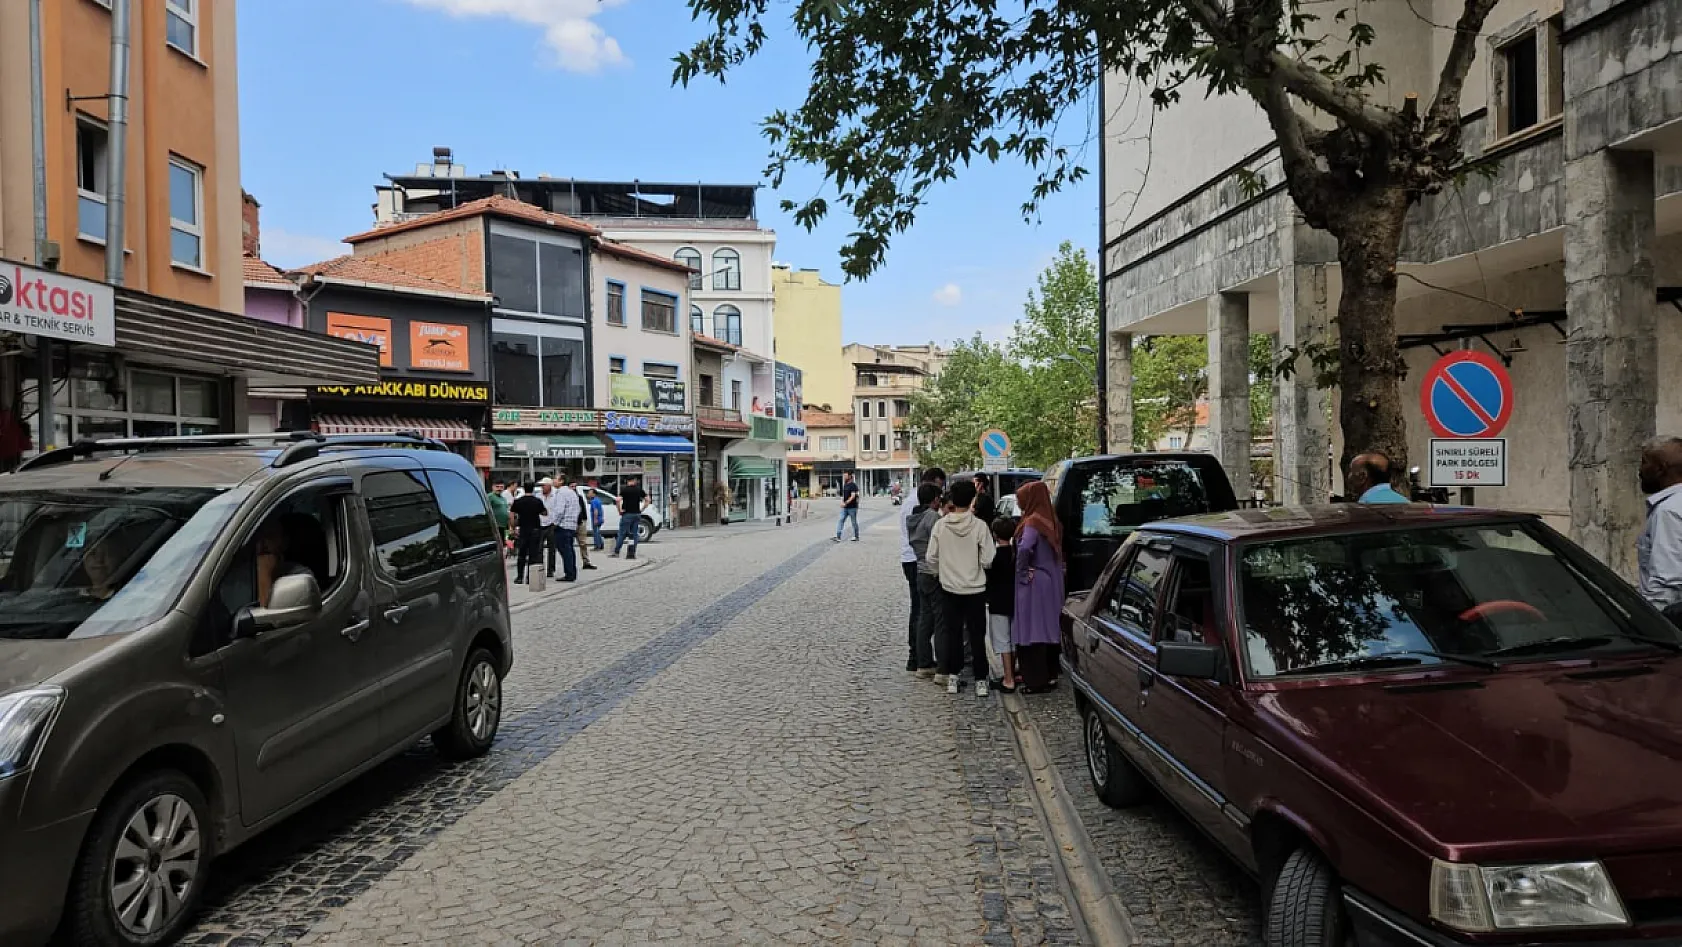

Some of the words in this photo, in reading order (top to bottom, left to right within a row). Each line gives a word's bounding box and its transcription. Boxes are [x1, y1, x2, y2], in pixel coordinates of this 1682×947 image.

[24, 315, 60, 331] TEKNİK
[63, 321, 95, 336] SERVİS
[429, 381, 488, 400] DÜNYASI
[1437, 459, 1459, 467] PARK
[1454, 470, 1465, 479] 15
